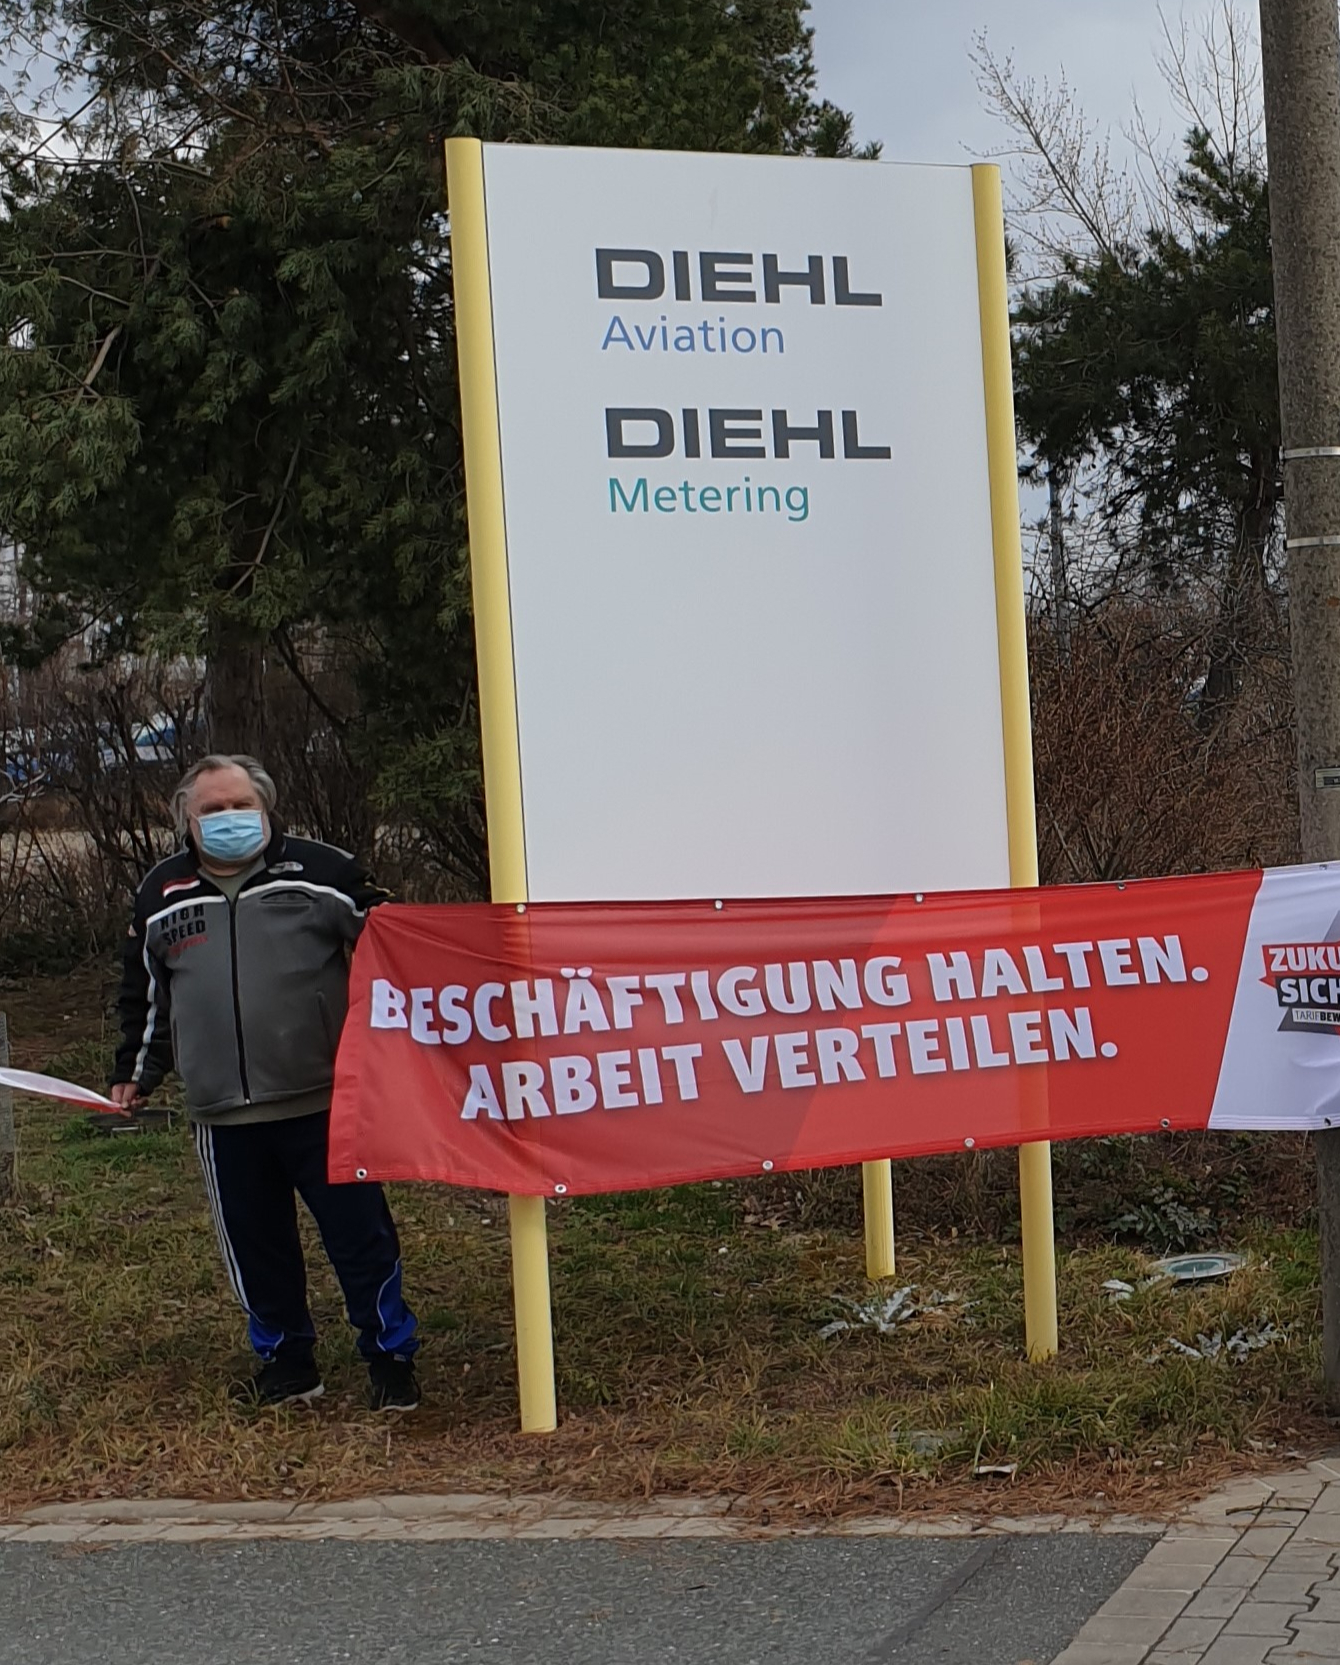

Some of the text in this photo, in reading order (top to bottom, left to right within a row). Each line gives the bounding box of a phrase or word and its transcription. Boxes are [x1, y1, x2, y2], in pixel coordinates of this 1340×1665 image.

[595, 248, 882, 307] DIEHL
[601, 315, 785, 353] Aviation
[605, 407, 892, 459] DIEHL
[608, 476, 810, 522] Metering
[160, 904, 205, 930] HIGH
[162, 919, 206, 946] SPEED
[370, 934, 1209, 1046] BESCHÄFTIGUNG HALTEN.
[460, 1007, 1118, 1121] ARBEIT VERTEILEN.
